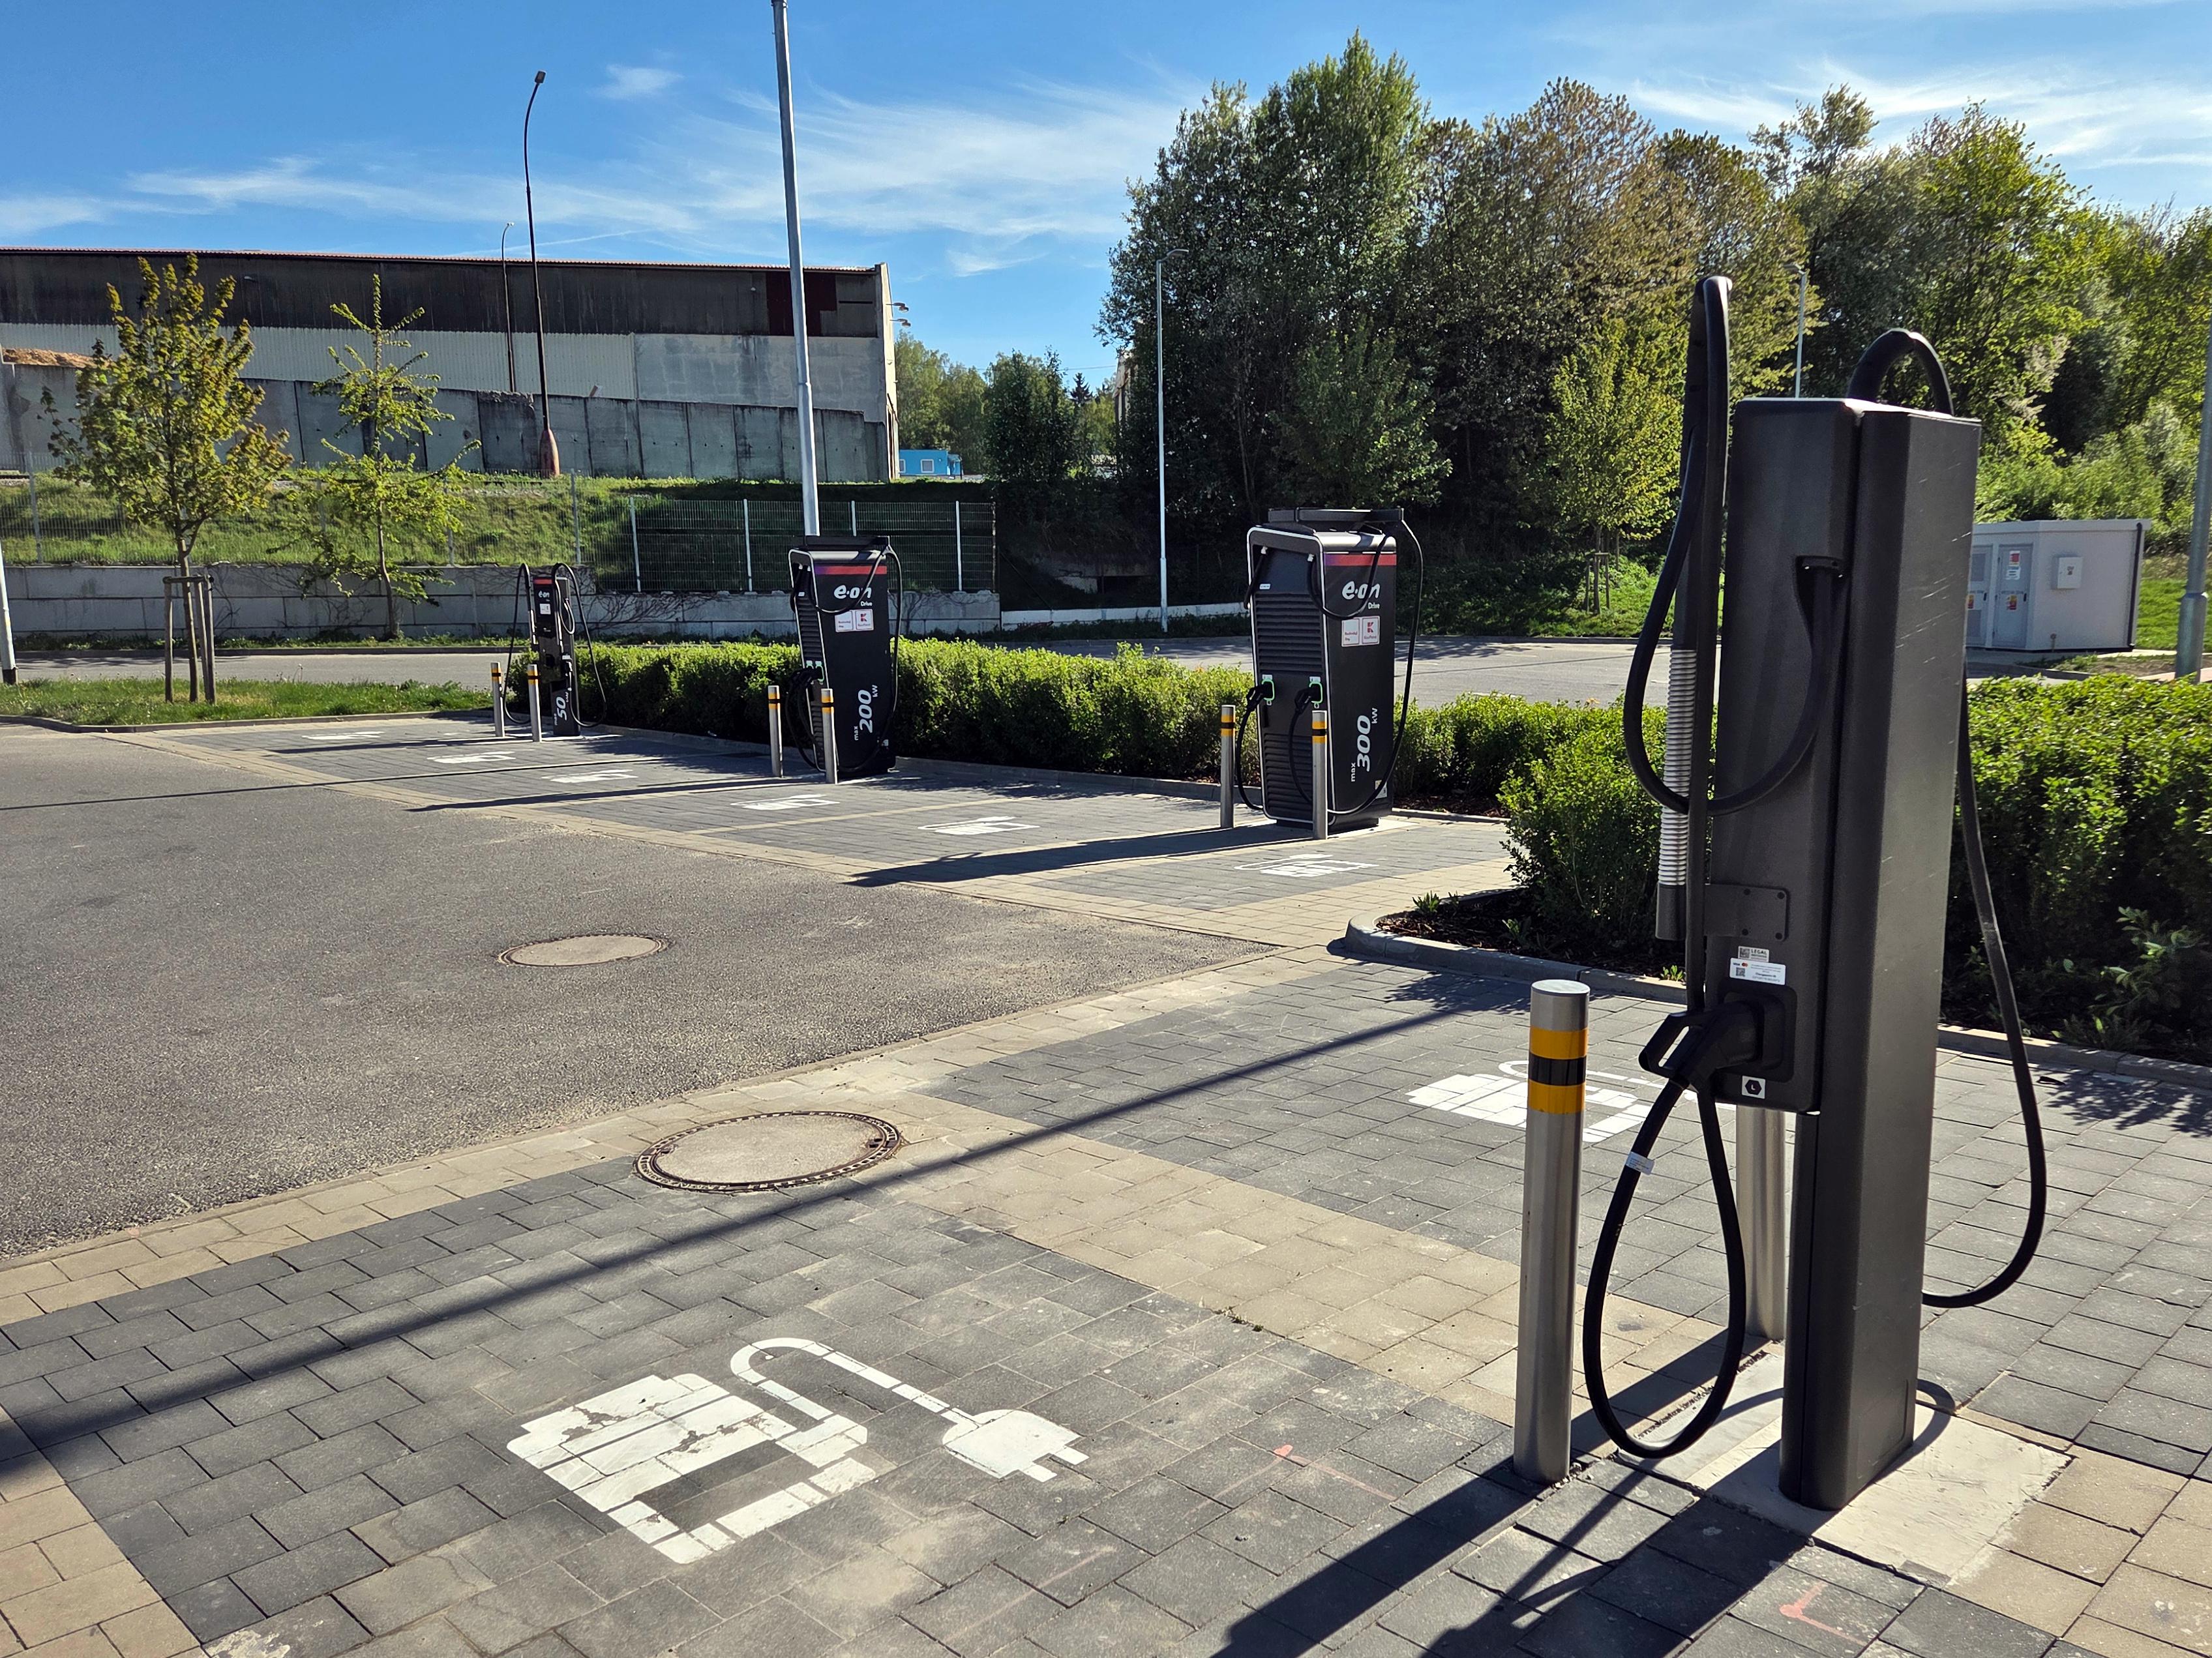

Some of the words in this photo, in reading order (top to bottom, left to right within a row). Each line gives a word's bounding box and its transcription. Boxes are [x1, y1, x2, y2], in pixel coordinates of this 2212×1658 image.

[556, 696, 567, 721] 50
[858, 689, 873, 733] 200
[871, 685, 878, 698] kW
[1357, 715, 1371, 772] 300
[1371, 707, 1378, 724] kW
